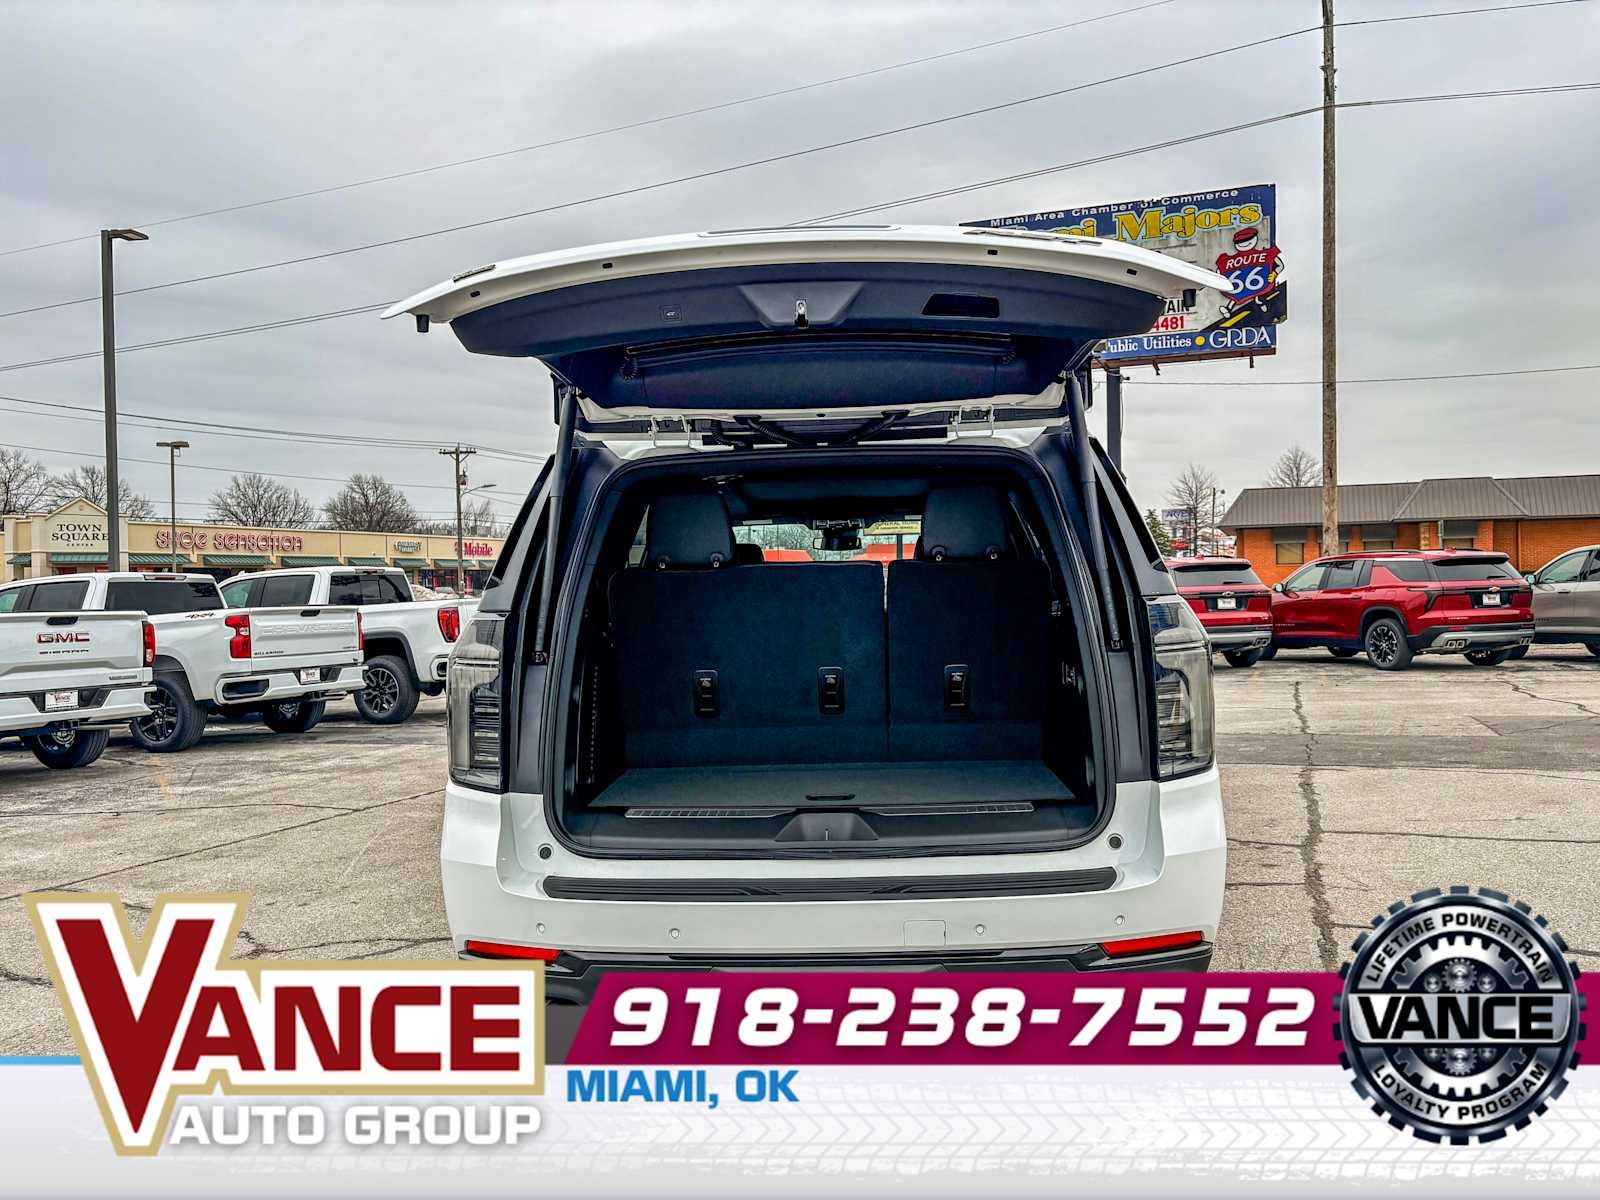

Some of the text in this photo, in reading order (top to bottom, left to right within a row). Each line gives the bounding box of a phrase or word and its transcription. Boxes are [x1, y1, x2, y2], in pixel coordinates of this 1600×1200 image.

[991, 214, 1029, 227] Miami
[1034, 212, 1065, 222] Area
[1071, 202, 1134, 217] Chamber
[1161, 189, 1239, 206] Commerce
[1115, 204, 1262, 241] Majors
[1225, 252, 1267, 270] ROUTE
[1227, 266, 1264, 294] 66
[1103, 326, 1271, 354] ublic Utilities GRDA
[57, 523, 102, 532] TOWN
[37, 633, 90, 644] GMC
